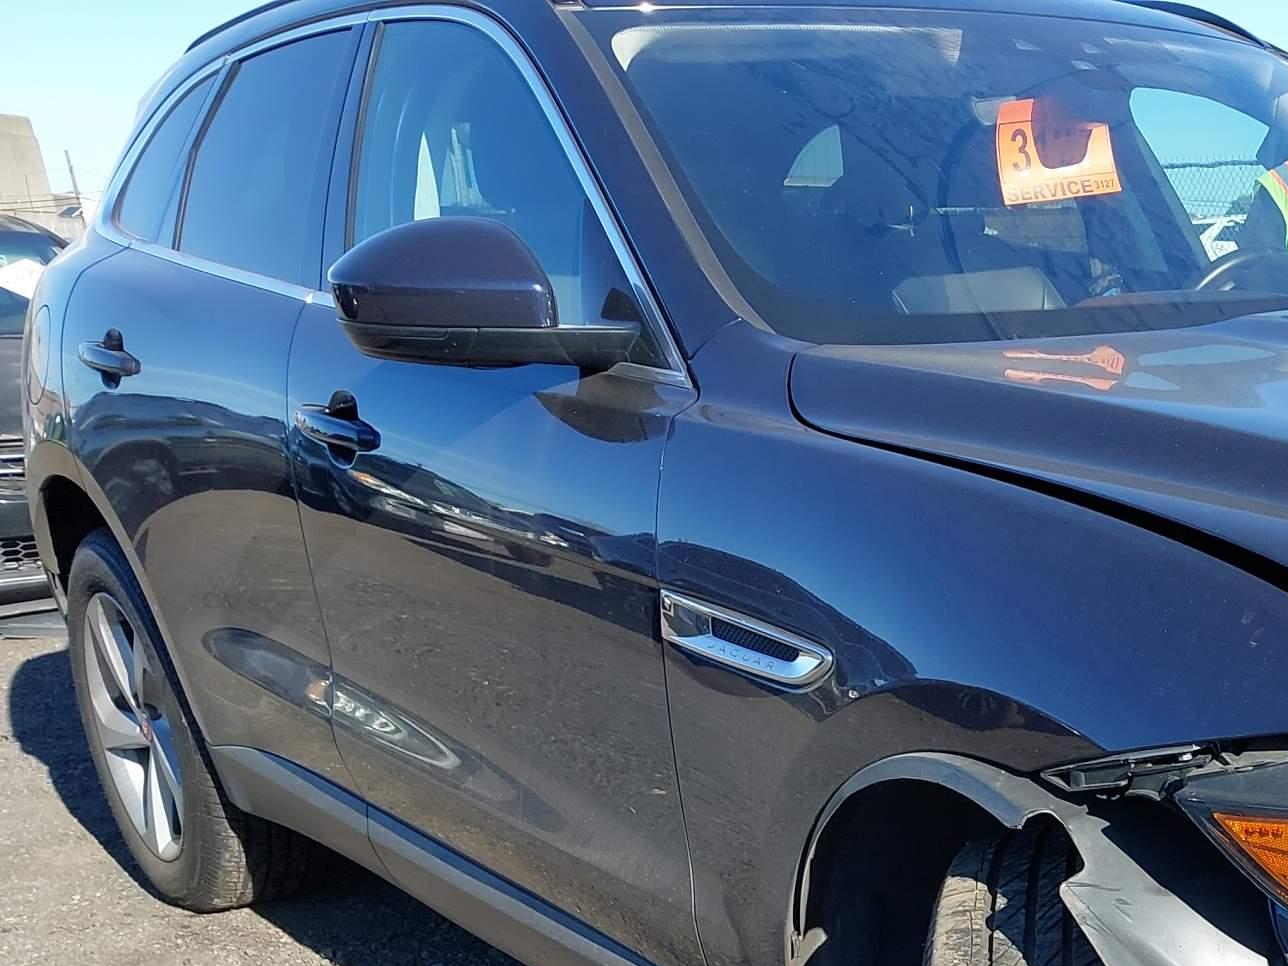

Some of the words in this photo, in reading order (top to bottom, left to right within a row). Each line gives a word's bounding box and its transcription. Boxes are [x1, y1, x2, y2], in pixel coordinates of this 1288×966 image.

[1008, 179, 1094, 202] SERVICE
[1094, 178, 1116, 190] 3127
[706, 643, 776, 672] JAGUAR
